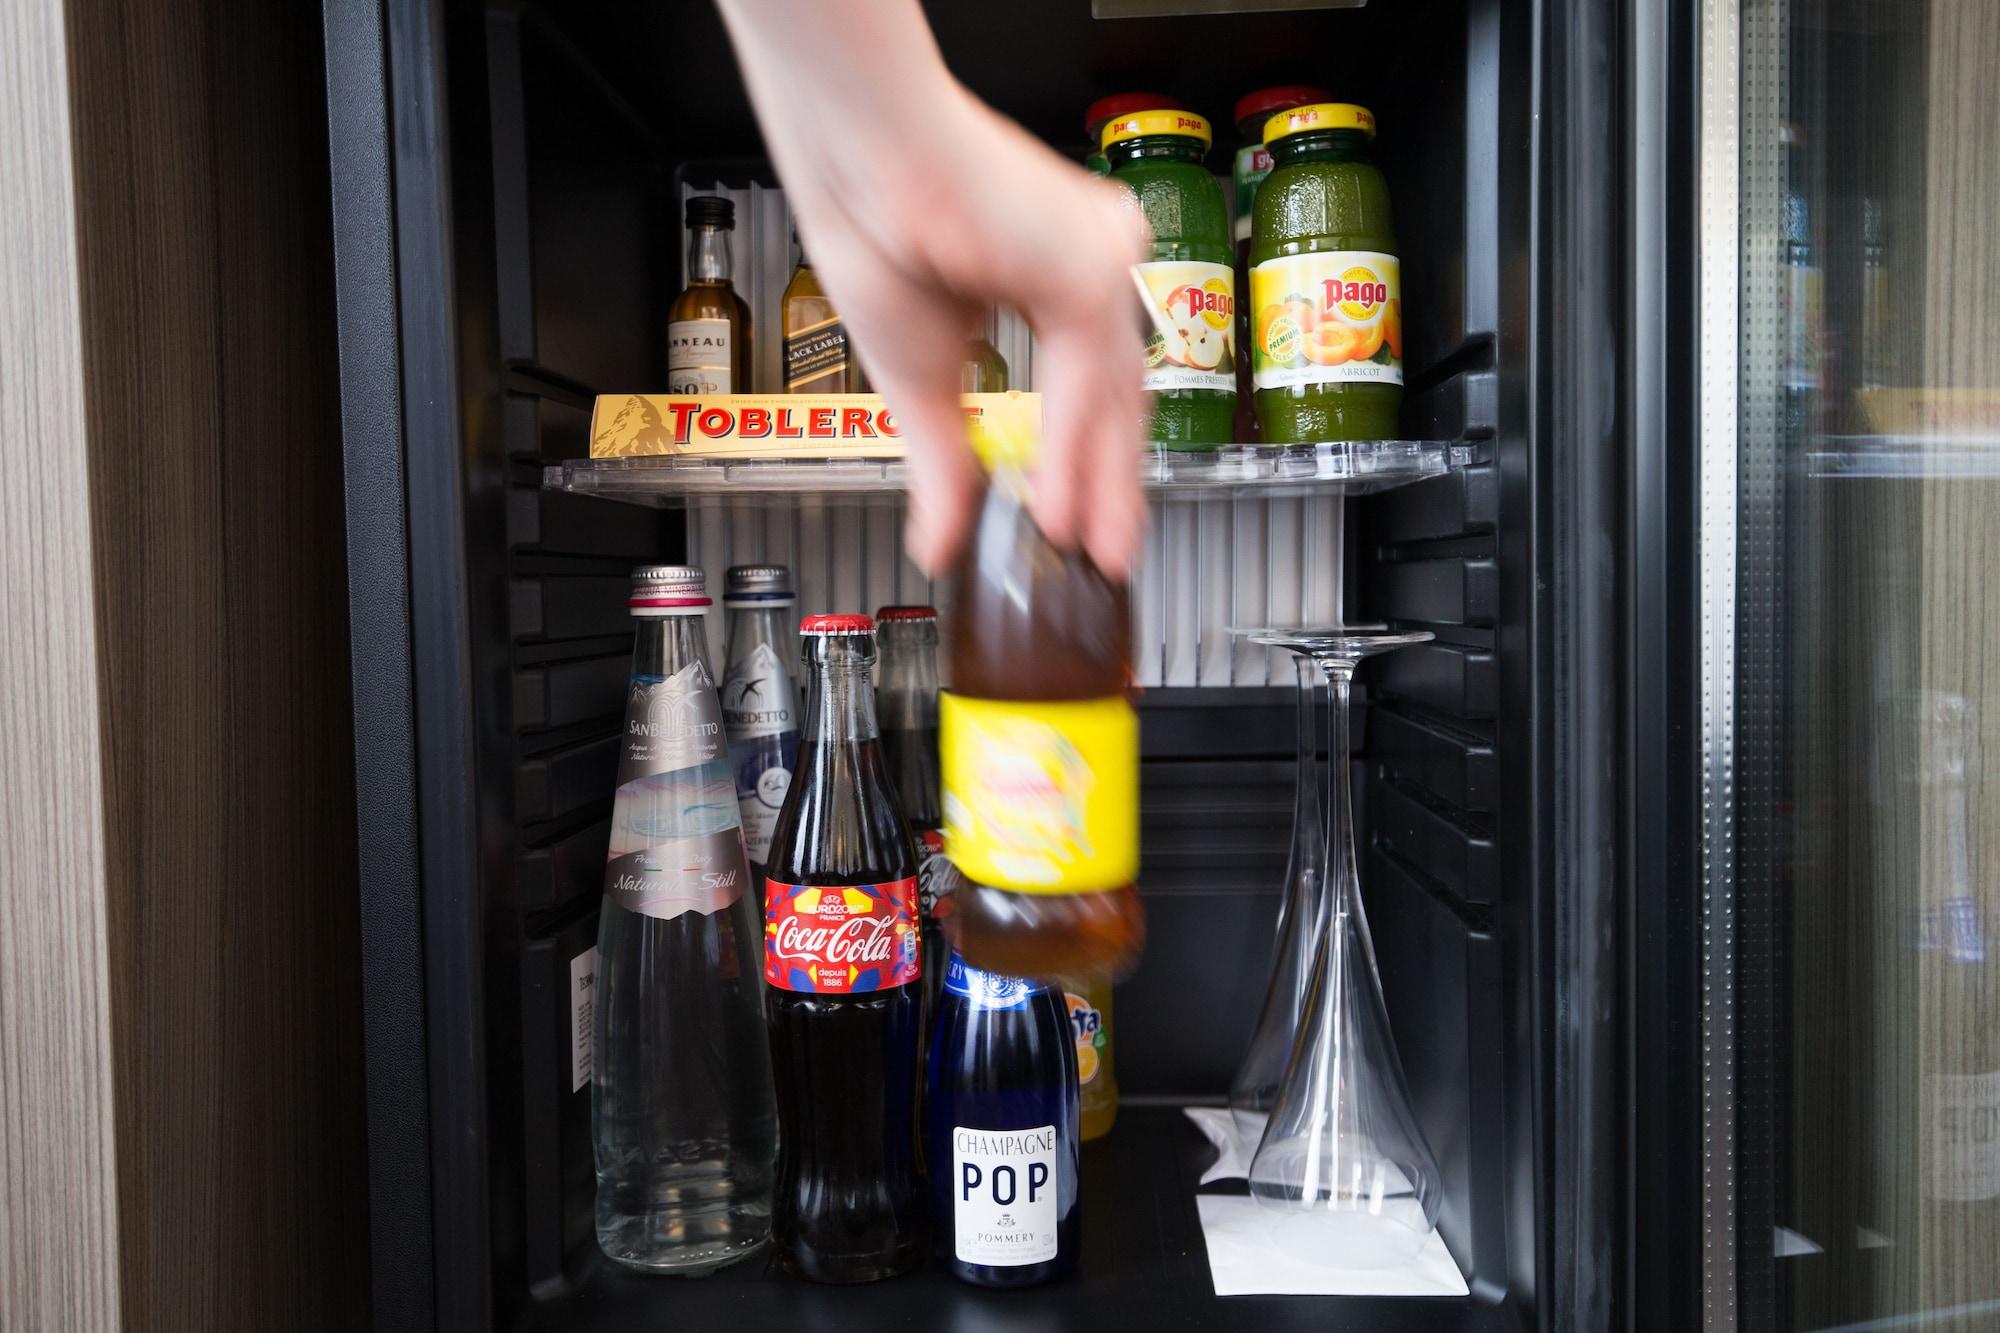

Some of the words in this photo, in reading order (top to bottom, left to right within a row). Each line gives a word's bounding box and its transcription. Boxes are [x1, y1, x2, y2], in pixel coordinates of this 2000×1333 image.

[1177, 117, 1202, 129] pago
[1321, 278, 1386, 311] pago
[669, 337, 725, 347] NNEAU
[786, 346, 814, 361] LACK
[814, 335, 845, 352] LABEL
[1269, 327, 1300, 351] PREMIUM
[1341, 367, 1381, 377] ABRICOT
[698, 869, 737, 891] Still
[775, 914, 898, 964] Coca-Cola
[818, 968, 847, 978] depuis
[822, 977, 843, 987] 1886
[956, 1130, 1054, 1156] CHAMPAGNE
[962, 1162, 1049, 1206] POP
[977, 1231, 1035, 1244] POMMERY
